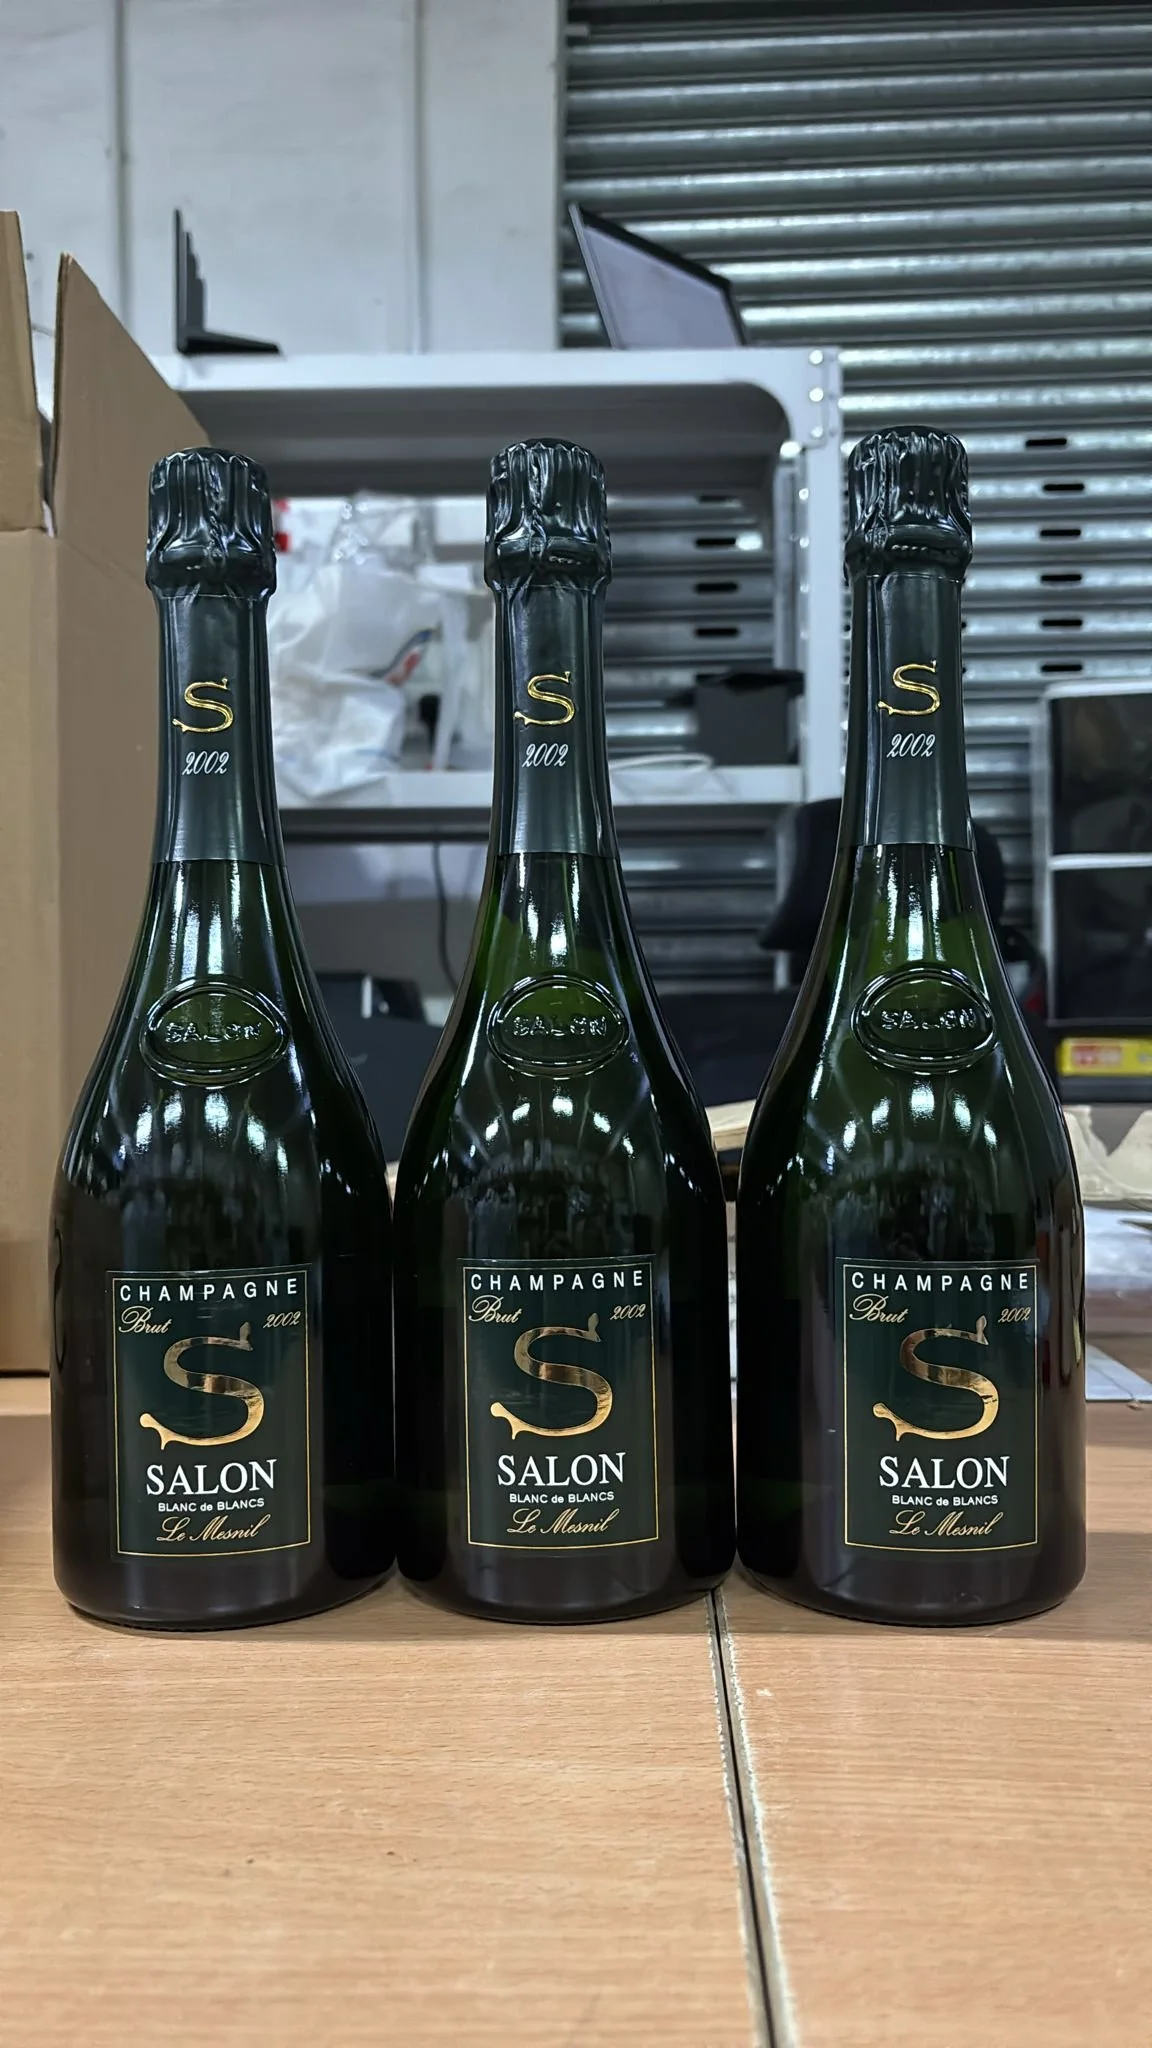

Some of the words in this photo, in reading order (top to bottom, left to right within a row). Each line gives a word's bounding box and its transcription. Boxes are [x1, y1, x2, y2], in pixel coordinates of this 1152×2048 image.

[514, 671, 575, 726] S
[877, 660, 940, 715] S
[172, 677, 234, 732] S
[522, 743, 569, 768] 2002
[886, 733, 936, 758] 2002
[182, 751, 230, 775] 2002
[120, 1278, 298, 1302] CHAMPAGNE
[470, 1270, 643, 1291] CHAMPAGNE
[851, 1271, 1028, 1291] CHAMPAGNE
[118, 1306, 173, 1335] Brut
[263, 1310, 301, 1329] 2002
[468, 1294, 523, 1323] Brut
[610, 1303, 647, 1321] 2002
[849, 1293, 909, 1323] Brut
[997, 1306, 1032, 1323] 2002
[139, 1322, 264, 1450] S
[490, 1312, 613, 1440] S
[873, 1315, 999, 1441] S
[146, 1458, 278, 1496] SALON
[497, 1452, 626, 1487] SALON
[879, 1455, 1011, 1490] SALON
[158, 1500, 197, 1512] BLANC
[200, 1501, 213, 1512] de
[217, 1498, 265, 1511] BLANCS
[509, 1493, 548, 1504] BLANC
[551, 1495, 565, 1504] de
[568, 1491, 615, 1503] BLANCS
[892, 1495, 933, 1506] BLANC
[936, 1496, 949, 1506] de
[953, 1495, 998, 1506] BLANCS
[156, 1516, 190, 1542] Le
[190, 1514, 271, 1541] Mesnil
[507, 1508, 541, 1534] Le
[540, 1508, 620, 1534] Mesnil
[889, 1510, 926, 1536] Le
[924, 1511, 1004, 1536] Mesnil
